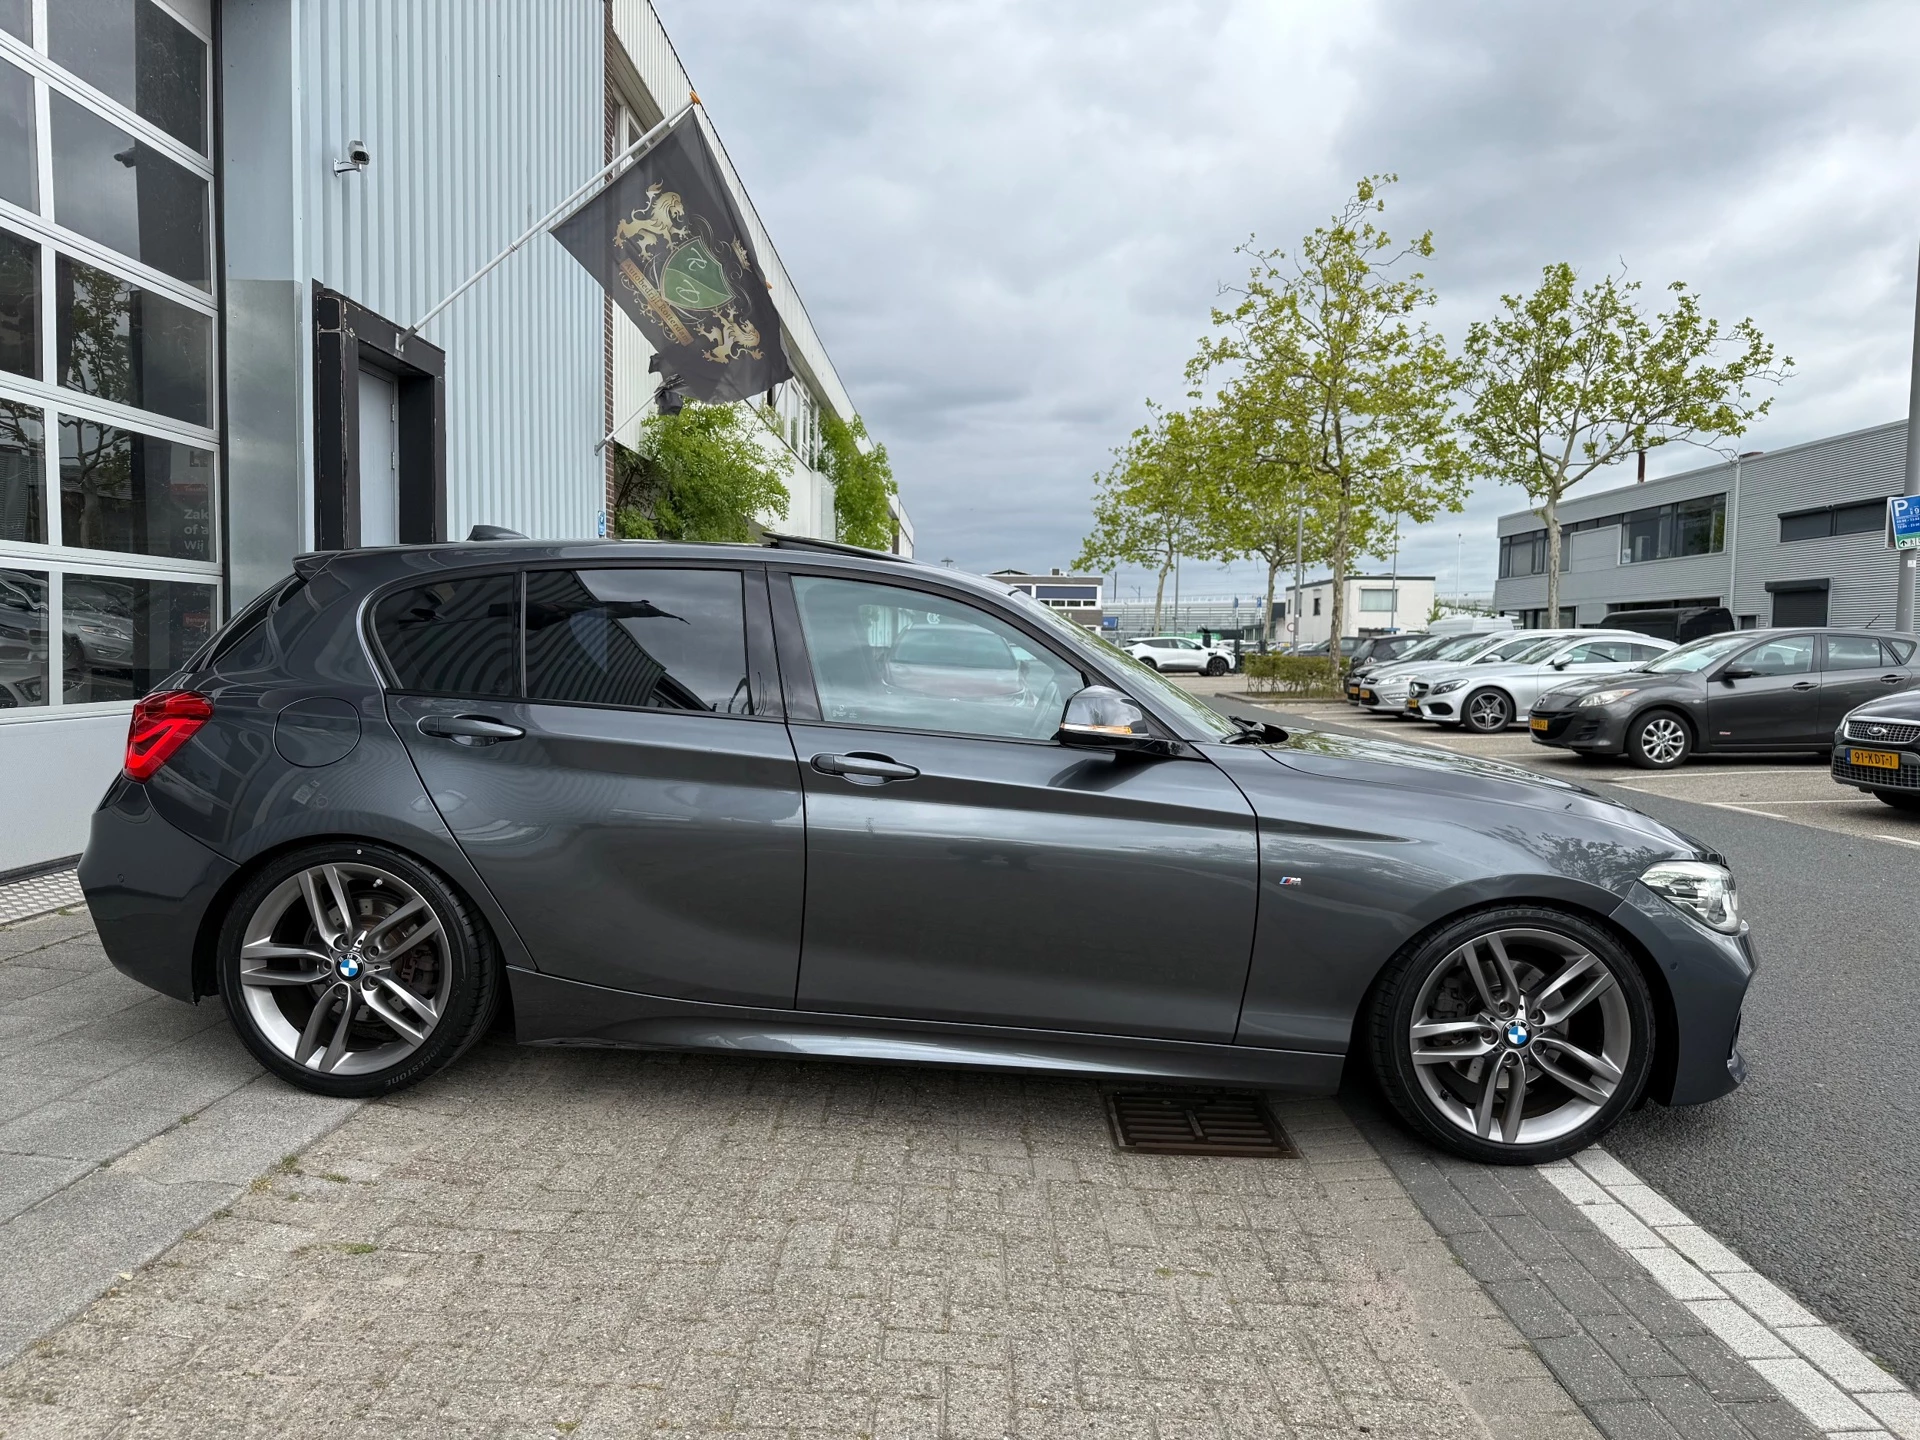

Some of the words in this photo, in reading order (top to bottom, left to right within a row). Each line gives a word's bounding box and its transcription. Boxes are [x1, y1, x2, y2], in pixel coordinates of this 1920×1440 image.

[625, 263, 661, 305] Autobedrijf
[659, 303, 690, 340] Rotterdam
[1894, 500, 1908, 516] P
[184, 509, 208, 519] Zak
[184, 524, 198, 534] of
[184, 540, 203, 551] Wij
[338, 953, 362, 964] BMW
[1505, 1020, 1531, 1031] BMW
